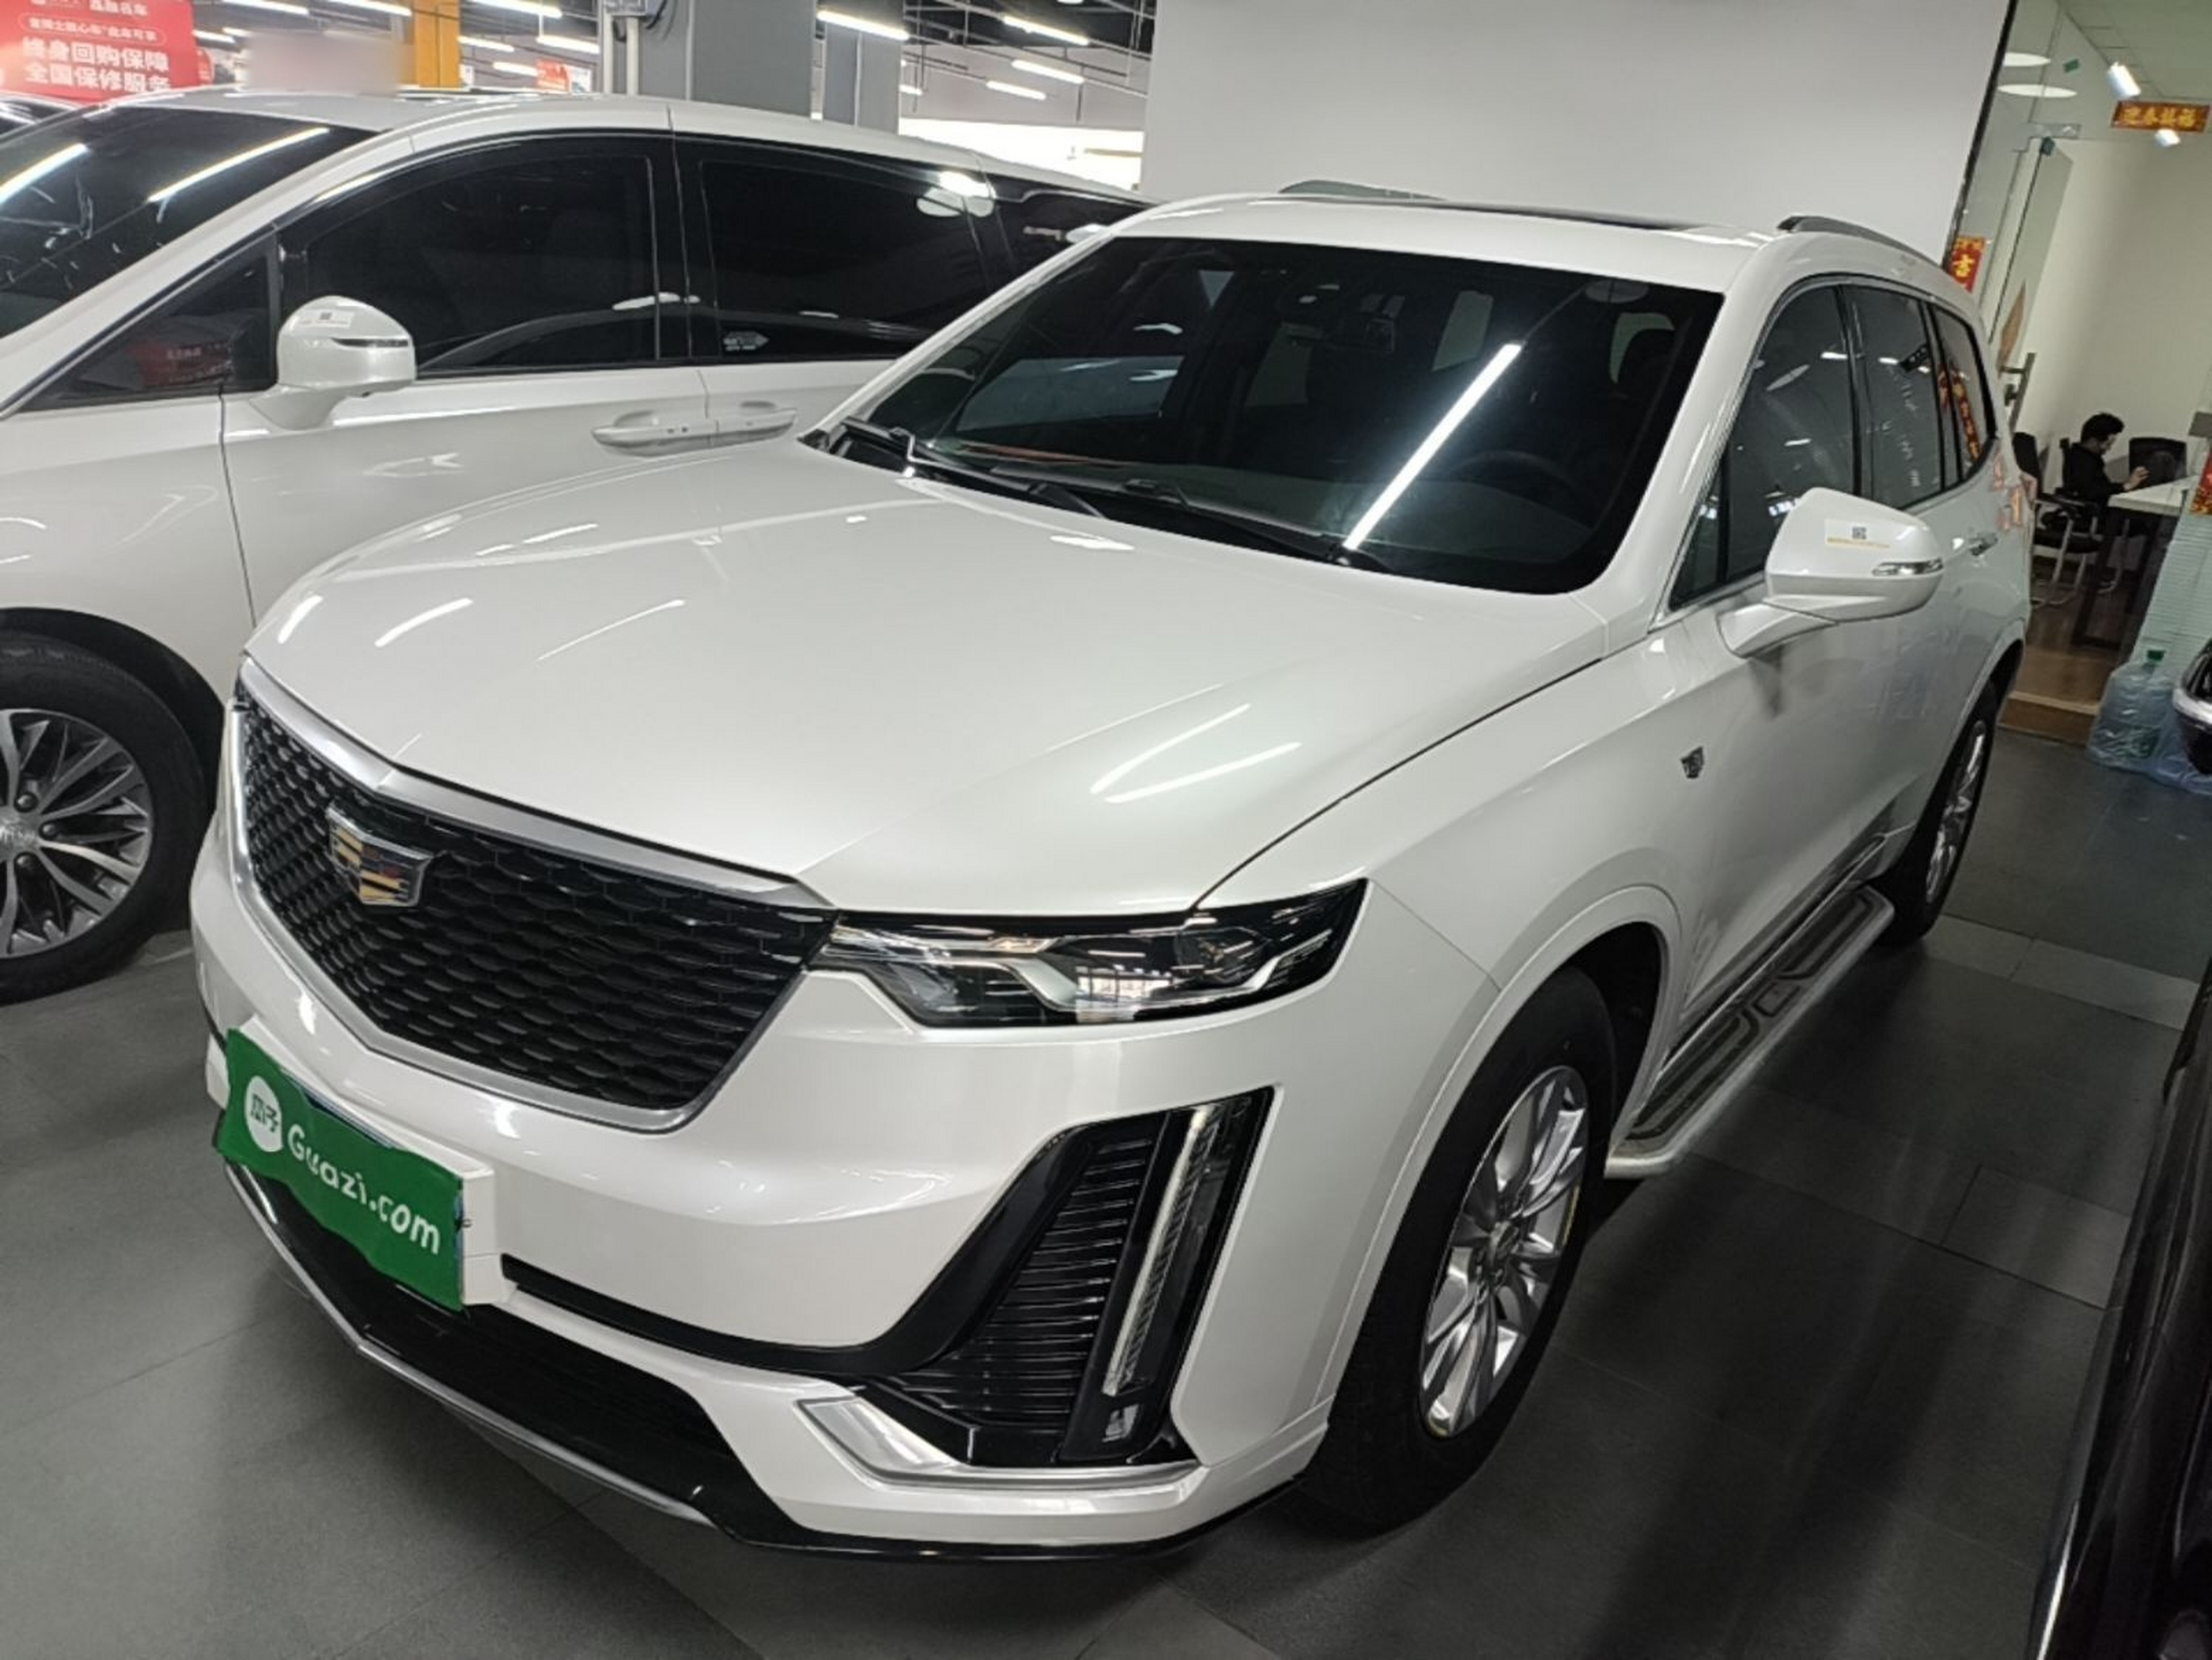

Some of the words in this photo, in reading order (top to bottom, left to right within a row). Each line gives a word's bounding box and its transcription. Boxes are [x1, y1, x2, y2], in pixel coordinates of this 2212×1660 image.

[23, 36, 169, 71] 终身回购保障
[288, 1124, 440, 1255] Guazi.com
